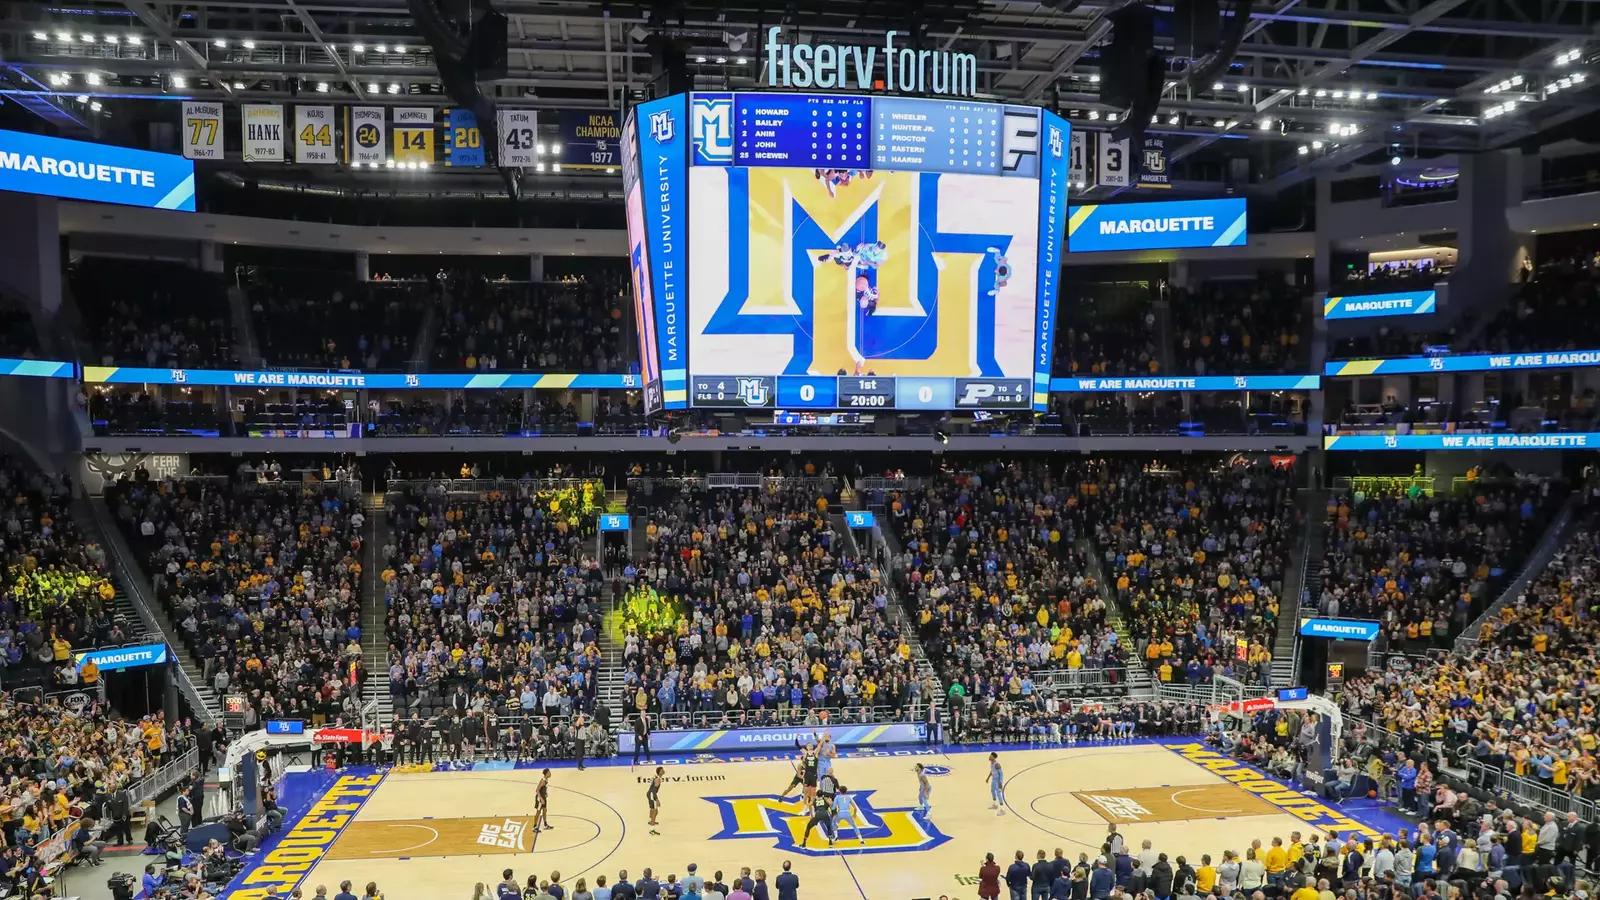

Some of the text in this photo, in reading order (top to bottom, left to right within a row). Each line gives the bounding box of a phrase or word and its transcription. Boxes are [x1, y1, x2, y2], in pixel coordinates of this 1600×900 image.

[307, 110, 324, 118] KOJIS
[355, 110, 381, 120] THOMPSON
[400, 112, 427, 120] MEMINGER
[510, 114, 529, 123] TATUM
[589, 115, 613, 126] NCAA
[188, 119, 218, 145] 77
[248, 124, 280, 140] HANK
[649, 109, 675, 144] MU
[300, 124, 331, 146] 44
[360, 128, 377, 144] 24
[402, 131, 426, 150] 14
[455, 128, 480, 148] 20
[506, 128, 534, 150] 43
[591, 152, 613, 163] 1977
[1107, 148, 1122, 171] 3
[1143, 150, 1166, 173] MU
[0, 150, 155, 188] MARQUETTE
[1100, 216, 1214, 235] MARQUETTE
[659, 155, 677, 361] MARQUETTE UNIVERSITY
[1040, 168, 1057, 365] MARQUETTE UNIVERSITY
[1345, 299, 1413, 311] MARQUETTE
[1490, 357, 1510, 367] WE
[1514, 356, 1543, 365] ARE
[170, 369, 188, 383] MU
[234, 373, 365, 385] WE ARE MARQUETTE
[405, 374, 420, 387] MU
[622, 375, 635, 387] MU
[859, 380, 876, 389] 1st
[1079, 379, 1195, 389] WE ARE MARQUETTE
[736, 378, 769, 406] MU
[800, 385, 815, 401] 0
[918, 386, 933, 402] 0
[958, 384, 995, 405] P
[851, 396, 884, 406] 20:00
[1443, 436, 1586, 446] WE ARE MARQUETTE
[153, 456, 180, 467] FEAR
[157, 468, 177, 478] THE
[608, 517, 620, 528] MU
[853, 514, 864, 525] MU
[1313, 624, 1366, 634] MARQUETTE
[92, 651, 152, 665] MARQUETTE
[1237, 647, 1246, 659] 30
[229, 704, 240, 712] 30
[1306, 770, 1324, 784] meijer
[477, 824, 501, 845] BIG
[497, 818, 522, 848] EAST
